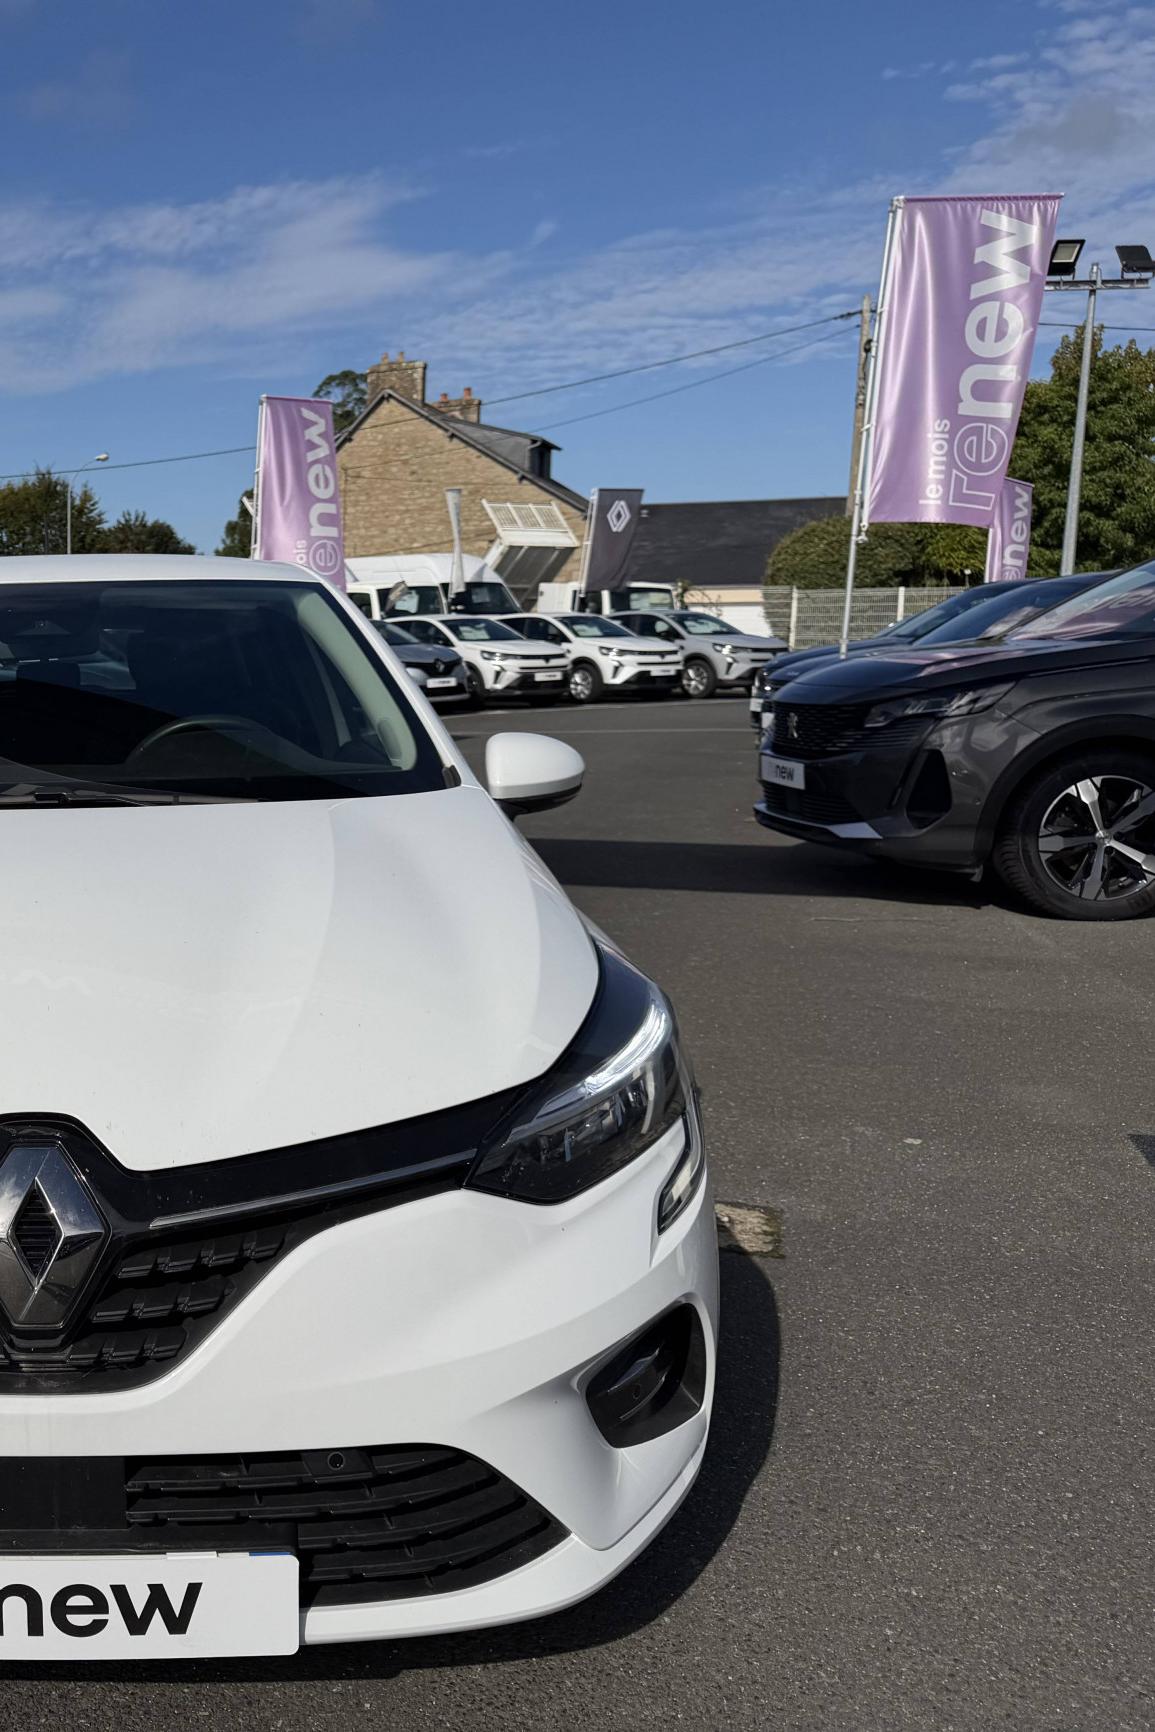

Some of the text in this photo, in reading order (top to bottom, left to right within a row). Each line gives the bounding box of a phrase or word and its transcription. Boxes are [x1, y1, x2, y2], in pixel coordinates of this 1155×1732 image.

[949, 208, 1038, 511] renew
[300, 406, 342, 578] enew
[918, 418, 951, 506] le mois
[1001, 486, 1030, 581] enew
